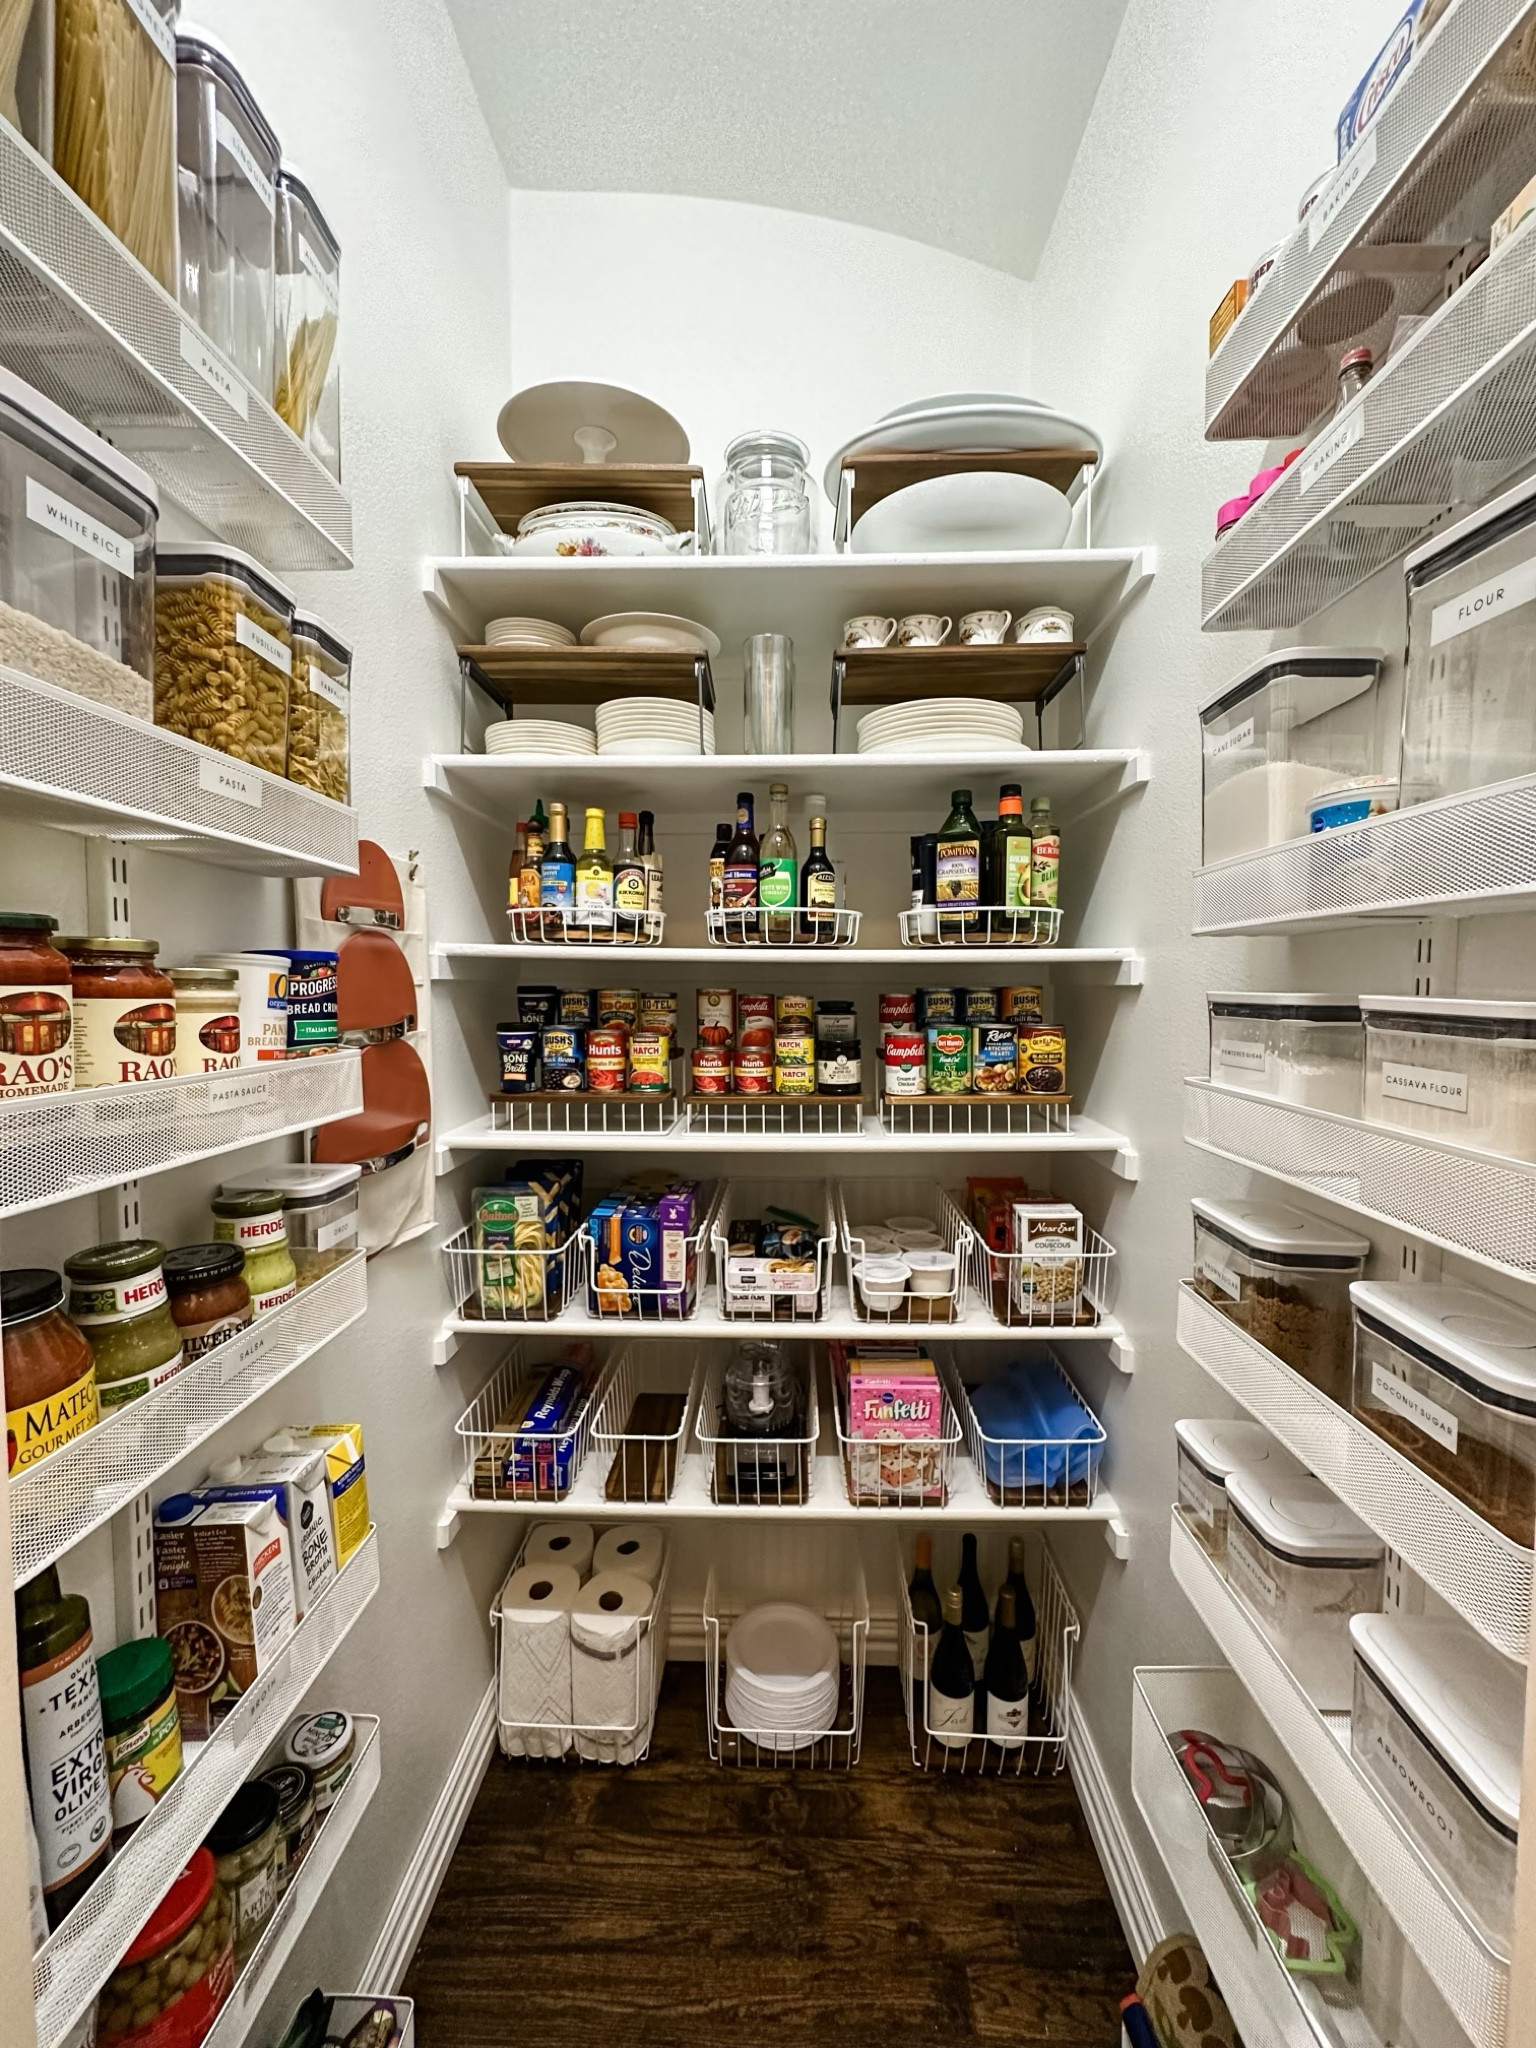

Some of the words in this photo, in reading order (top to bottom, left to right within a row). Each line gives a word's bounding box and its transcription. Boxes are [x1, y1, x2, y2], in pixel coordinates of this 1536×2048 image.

[1323, 167, 1359, 222] BAKING
[201, 358, 232, 393] PASTA
[1313, 431, 1349, 473] BAKING
[46, 503, 88, 537] WHITE
[93, 531, 121, 558] RICE
[1458, 587, 1506, 621] FLOUR
[251, 632, 284, 660] FUSILLINI
[1229, 728, 1251, 747] SUGAR
[219, 775, 247, 793] PASTA
[940, 847, 975, 858] POMPEIAN
[1042, 869, 1058, 882] OLIV
[290, 976, 338, 996] PROGRES
[287, 1002, 320, 1015] BREAD
[323, 1001, 338, 1014] CRUM
[881, 1003, 915, 1015] Campbell
[263, 1023, 287, 1036] PAN
[544, 1035, 573, 1045] BUSH'S
[987, 1030, 1012, 1042] Reese
[0, 1055, 72, 1086] AO'S
[504, 1063, 527, 1073] Broth
[213, 1089, 239, 1102] PASTA
[241, 1084, 267, 1097] SAUCE
[1386, 1075, 1427, 1090] CASSAVA
[1429, 1083, 1462, 1096] FLOUR
[240, 1218, 285, 1238] HERDEZ
[1030, 1222, 1057, 1233] Near
[1057, 1222, 1075, 1233] East
[124, 1278, 165, 1304] HERD
[259, 1288, 296, 1311] HERDEZ
[183, 1328, 234, 1353] ILVER
[239, 1339, 264, 1362] SALSA
[153, 1362, 182, 1388] HERD
[534, 1383, 561, 1419] Reynolds
[863, 1399, 931, 1420] Funfetti
[1376, 1378, 1418, 1412] COCONUT
[1420, 1408, 1453, 1436] SUGAR
[19, 1418, 86, 1464] GOURMET
[254, 1541, 279, 1569] CHICKEN
[302, 1529, 328, 1567] BONE
[305, 1544, 328, 1576] BROTH
[158, 1560, 191, 1574] Tonight
[308, 1556, 332, 1590] CHICKEN
[1251, 1568, 1272, 1594] FLOUR
[70, 1654, 92, 1680] OLIVE
[49, 1663, 97, 1712] TEXA
[251, 1677, 278, 1715] BROTH
[51, 1728, 104, 1787] EXTR
[51, 1752, 107, 1804] VIRGI
[1378, 1736, 1453, 1840] ARROWROOT
[55, 1780, 101, 1823] OLIVE
